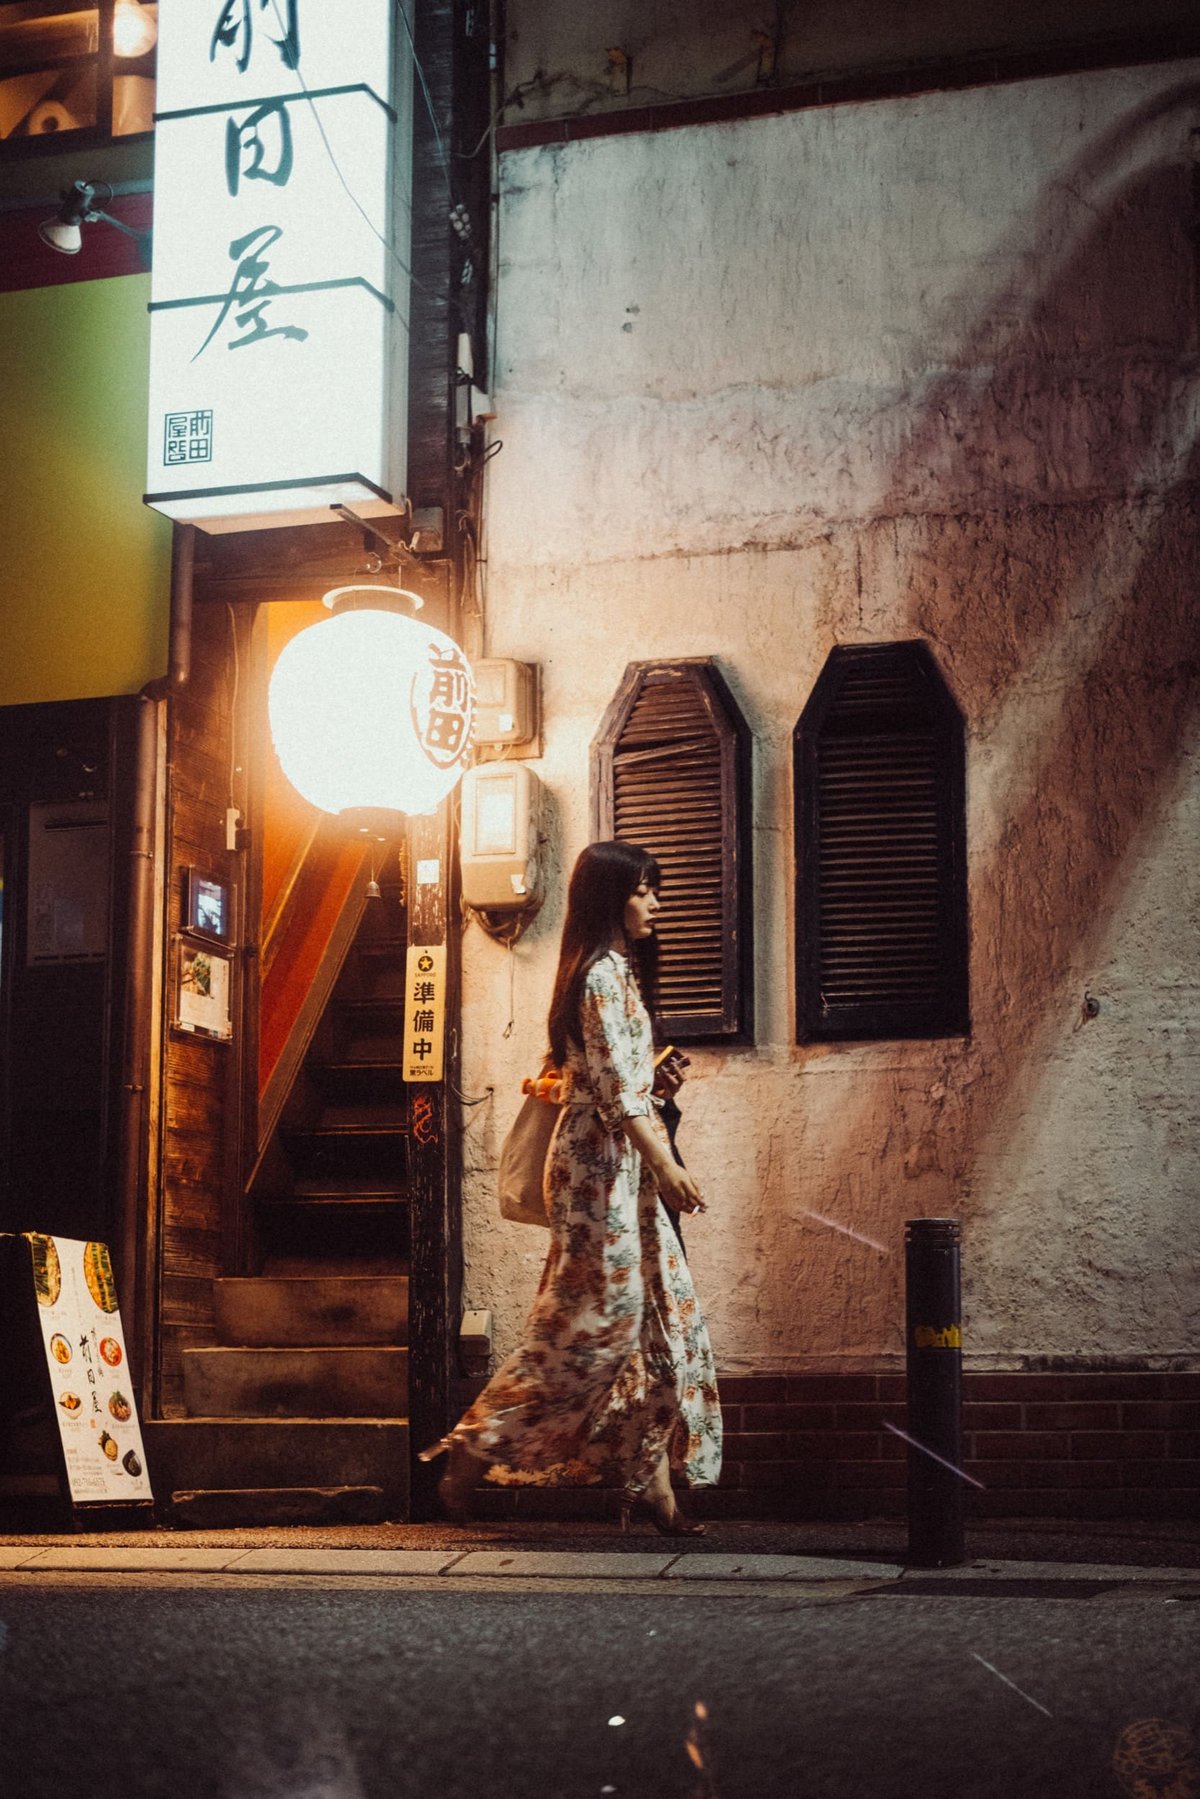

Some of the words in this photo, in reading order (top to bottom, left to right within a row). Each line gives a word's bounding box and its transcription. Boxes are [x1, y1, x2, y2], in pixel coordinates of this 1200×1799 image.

[427, 643, 467, 753] 前田
[412, 982, 435, 1061] 準備中
